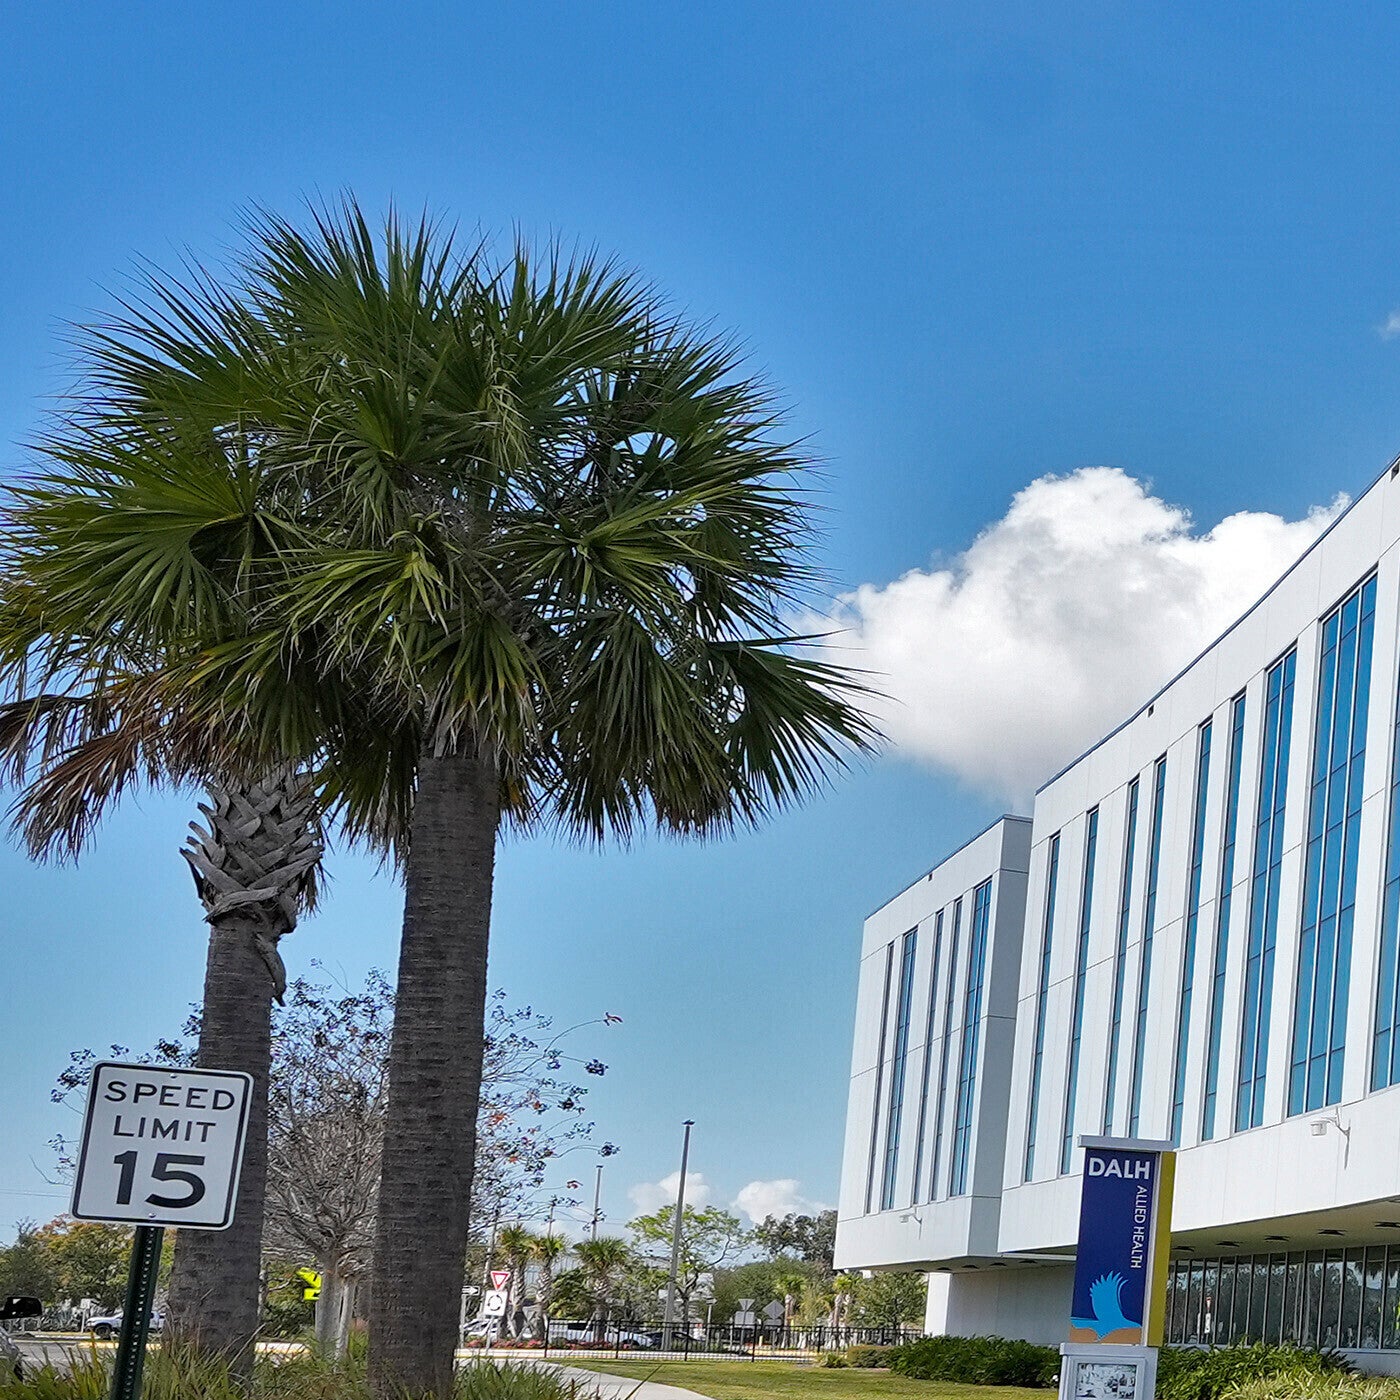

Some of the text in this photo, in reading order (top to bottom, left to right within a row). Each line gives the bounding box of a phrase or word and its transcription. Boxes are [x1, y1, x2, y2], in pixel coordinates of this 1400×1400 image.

[104, 1080, 236, 1111] SPEED
[112, 1114, 217, 1143] LIMIT
[112, 1150, 207, 1209] 15
[1088, 1157, 1151, 1180] DALH
[1130, 1185, 1148, 1269] ALLIED HEALTH
